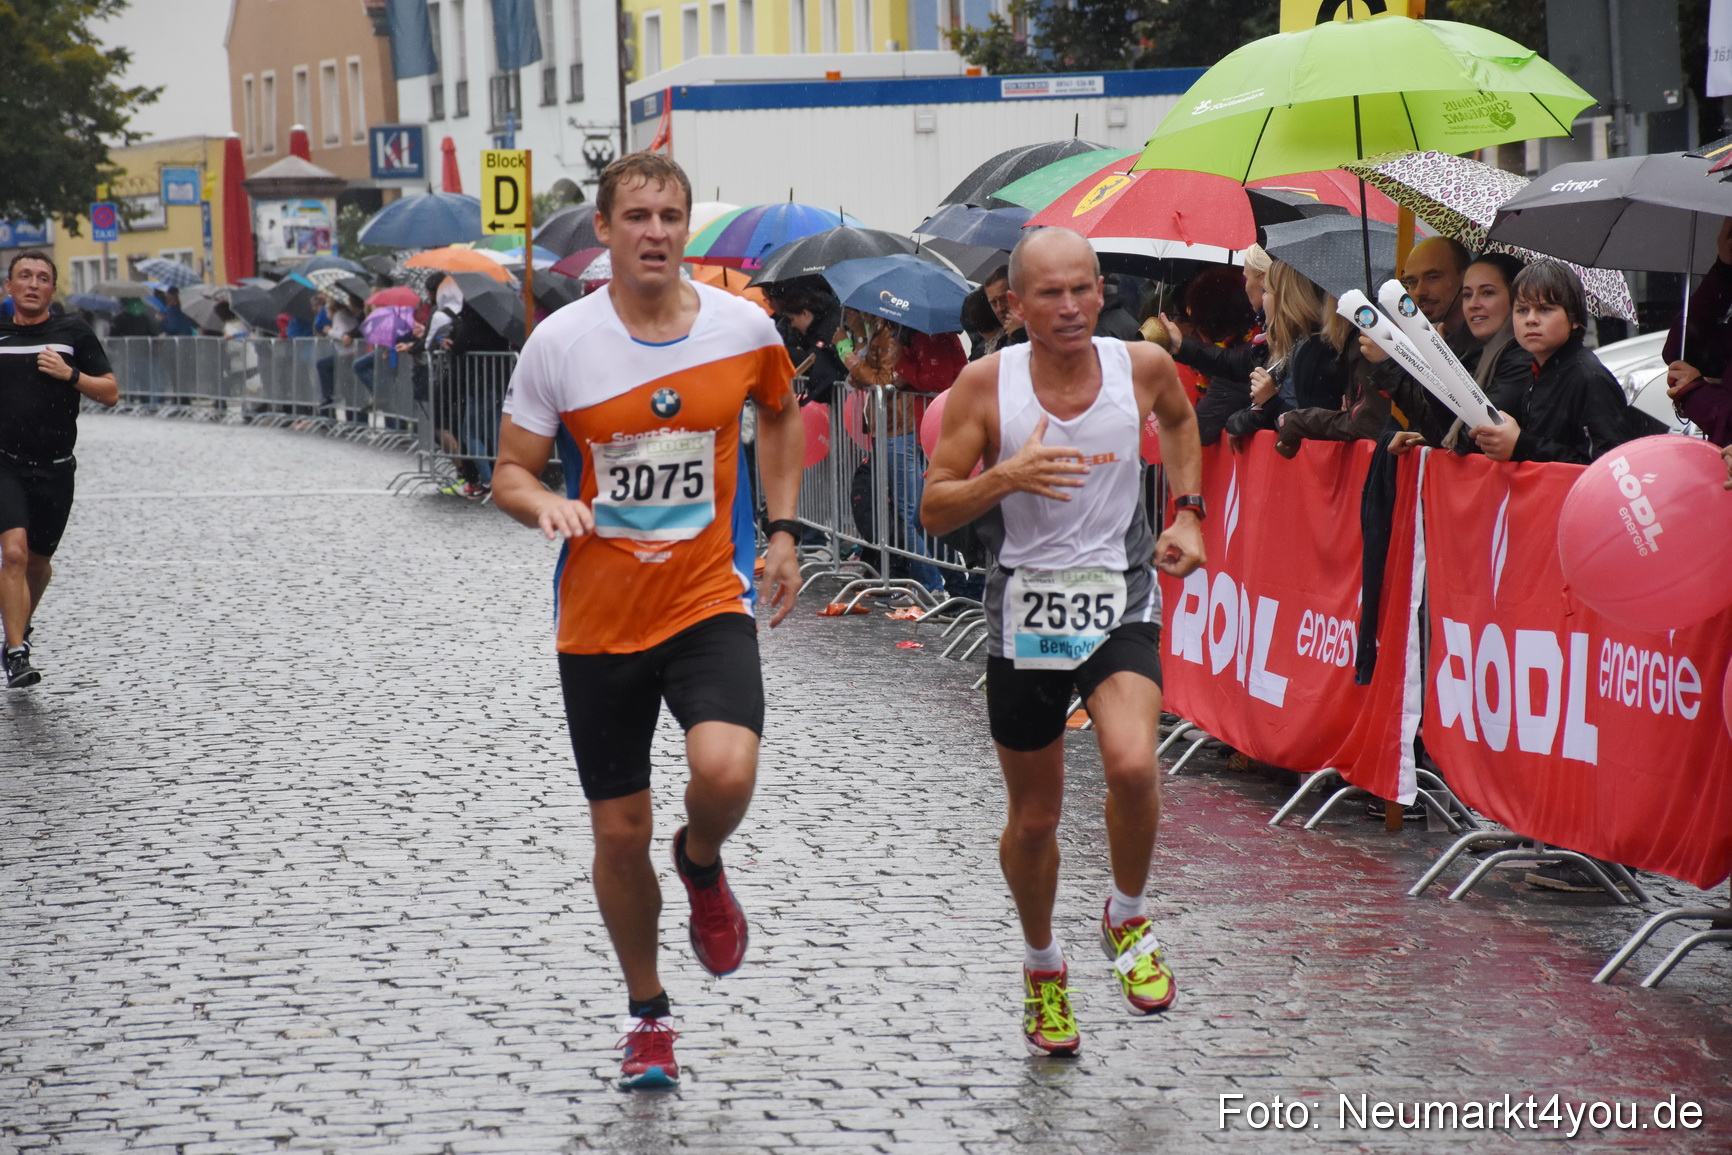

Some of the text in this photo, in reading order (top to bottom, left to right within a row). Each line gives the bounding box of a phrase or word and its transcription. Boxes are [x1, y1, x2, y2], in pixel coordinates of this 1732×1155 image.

[376, 131, 418, 169] KL
[487, 153, 525, 168] Block
[494, 175, 519, 215] D
[95, 230, 115, 239] TAXI
[891, 296, 909, 308] epp
[609, 460, 704, 502] 3075
[1619, 507, 1648, 556] energie
[1023, 592, 1115, 631] 2535
[1600, 637, 1702, 720] energie
